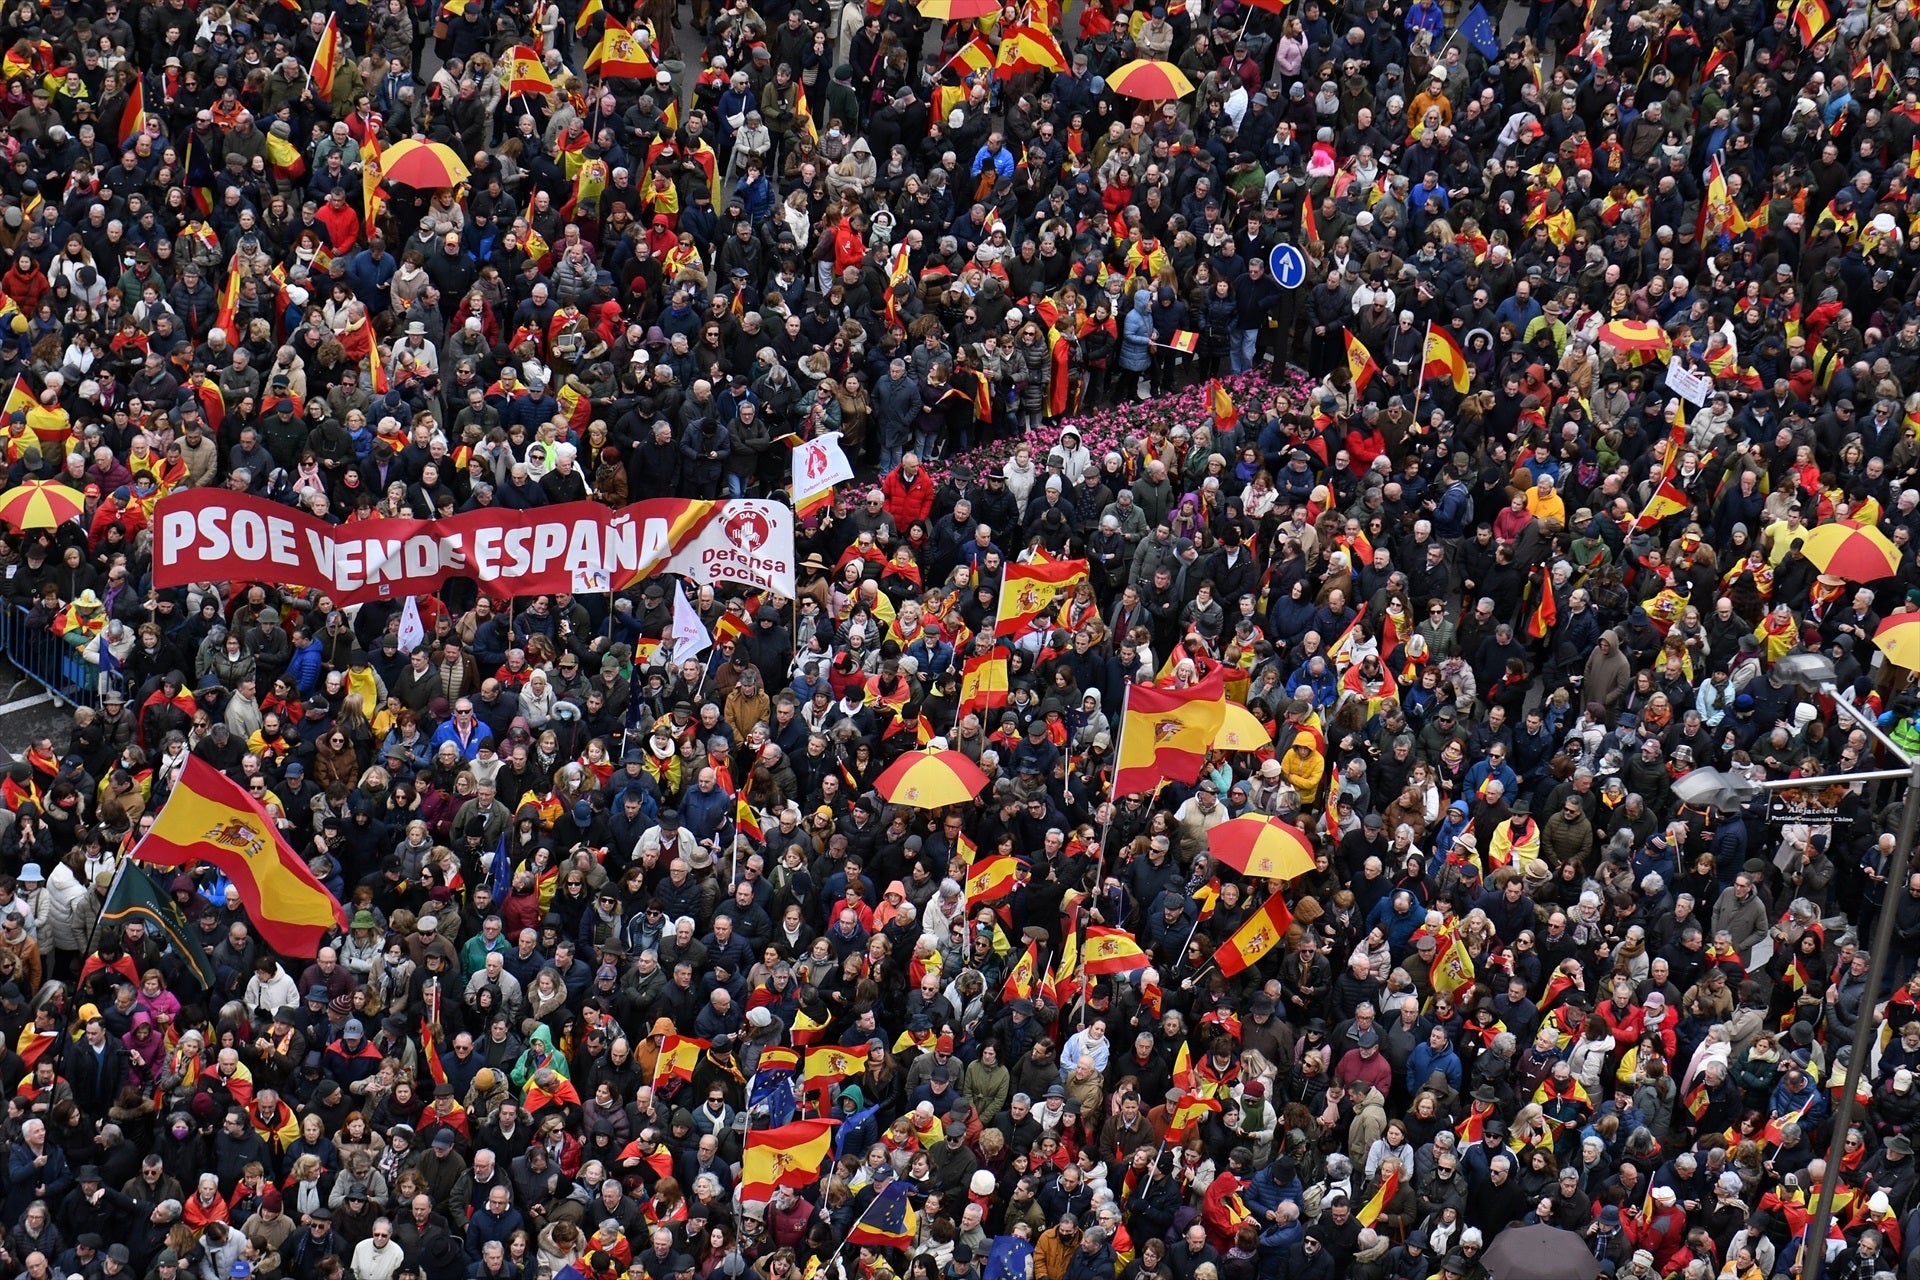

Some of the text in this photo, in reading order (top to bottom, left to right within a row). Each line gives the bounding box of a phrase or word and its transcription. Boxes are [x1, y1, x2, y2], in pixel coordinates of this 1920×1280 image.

[740, 512, 757, 520] DAS
[162, 506, 672, 591] PSOE VENDE ESPAÑA
[702, 548, 786, 574] Defensa
[709, 563, 773, 588] Social
